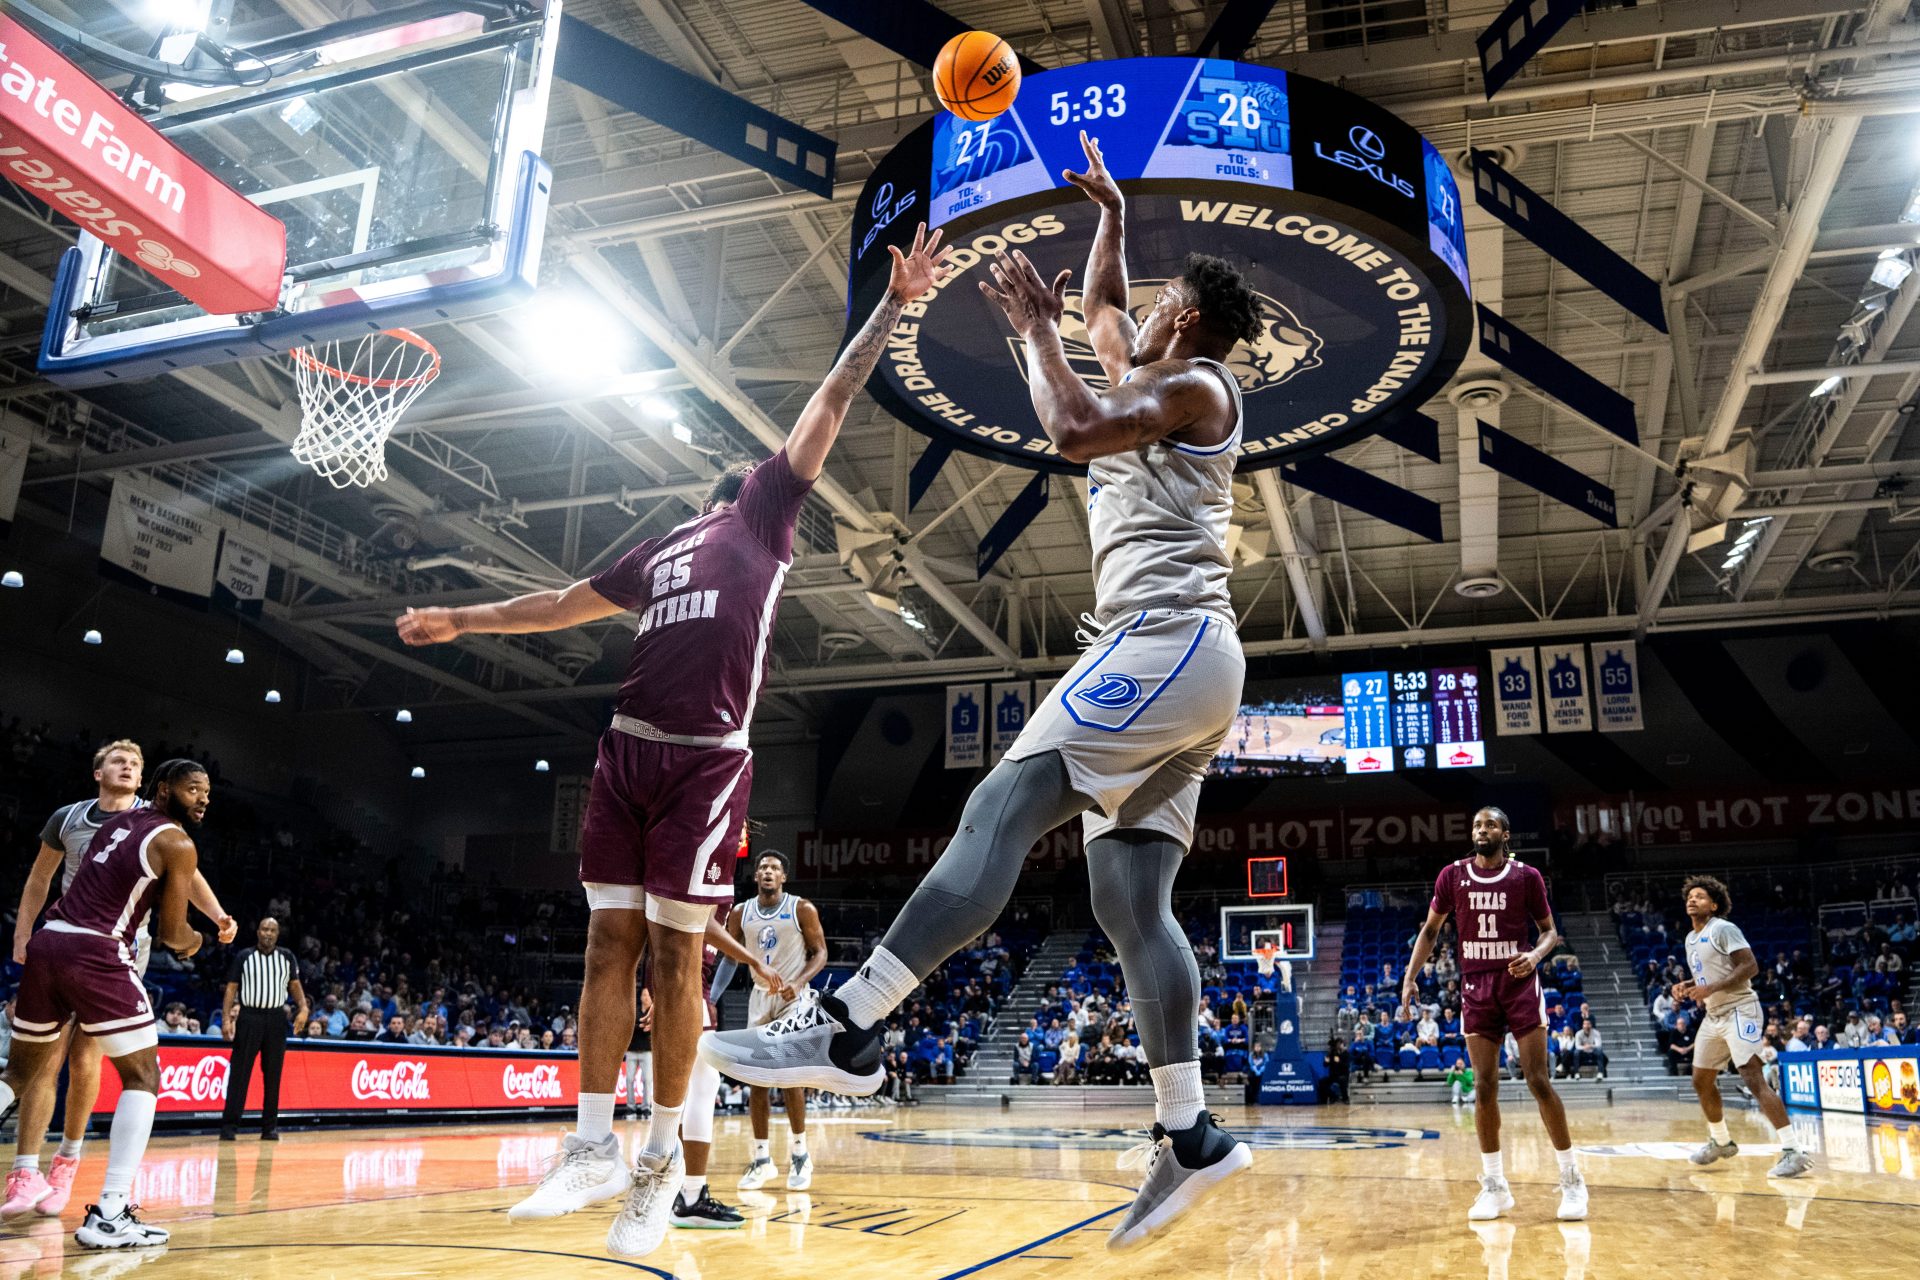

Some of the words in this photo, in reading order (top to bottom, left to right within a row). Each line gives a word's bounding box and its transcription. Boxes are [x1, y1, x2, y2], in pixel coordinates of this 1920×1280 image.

[1050, 84, 1127, 126] 5:33
[1218, 93, 1260, 130] 26
[956, 121, 992, 167] 27
[1227, 153, 1248, 165] TO:
[1314, 141, 1415, 199] LEXUS
[1216, 164, 1260, 179] FOULS:
[958, 187, 974, 199] TO:
[948, 195, 983, 215] FOULS:
[858, 190, 916, 261] LEXUS
[1179, 200, 1393, 273] WELCOME
[1375, 268, 1420, 301] TO
[1397, 302, 1432, 346] THE
[887, 322, 937, 391] DRAKE
[1350, 350, 1426, 413] KNAPP
[916, 392, 976, 427] THE
[971, 425, 1021, 443] OF
[1236, 413, 1349, 457] CENTE
[156, 506, 203, 534] BASKETBALL
[150, 521, 194, 546] CHAMPIONS
[652, 552, 694, 598] 25
[230, 577, 254, 596] 2023
[1366, 679, 1382, 694] 27
[1394, 672, 1427, 690] 5:33
[1438, 674, 1455, 690] 26
[1504, 674, 1526, 692] 33
[1554, 671, 1576, 689] 13
[1605, 667, 1627, 685] 55
[1502, 701, 1532, 711] WANDA
[1553, 708, 1584, 718] JENSEN
[1559, 699, 1577, 708] JAN
[1602, 706, 1637, 716] BAUMAN
[960, 709, 970, 726] 5
[1001, 706, 1021, 724] 15
[1506, 711, 1528, 721] FORD
[634, 722, 671, 739] TIGERS
[1697, 797, 1789, 830] HOT
[1806, 787, 1920, 824] ZONE
[1249, 819, 1334, 850] HOT
[1350, 813, 1469, 846] ZONE
[93, 827, 131, 863] 7
[804, 837, 895, 872] HyVee
[1468, 892, 1507, 910] TEXAS
[1477, 914, 1498, 938] 11
[1462, 941, 1518, 960] SOUTHERN
[351, 1059, 430, 1100] Coca-Cola
[502, 1063, 562, 1100] Coca-Cola
[1286, 1084, 1314, 1092] DEALERS
[1788, 1064, 1815, 1093] FMH
